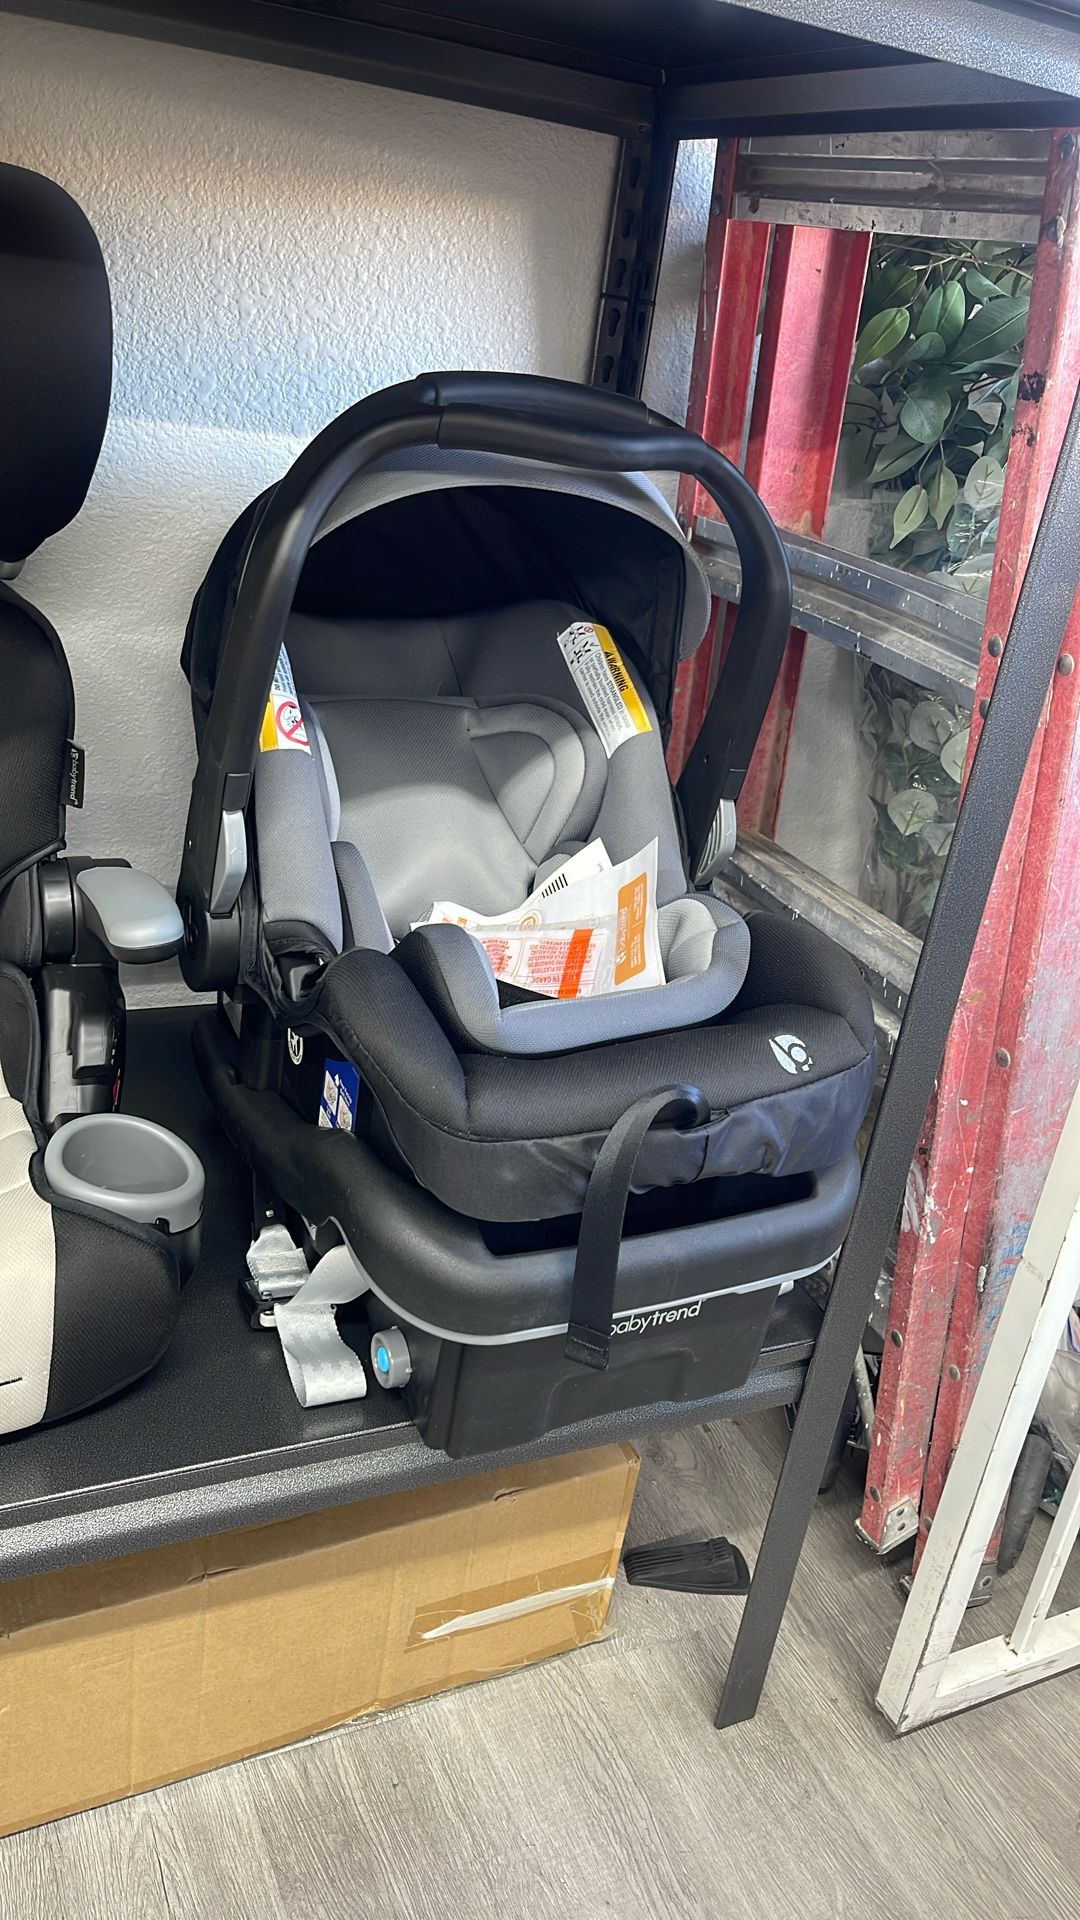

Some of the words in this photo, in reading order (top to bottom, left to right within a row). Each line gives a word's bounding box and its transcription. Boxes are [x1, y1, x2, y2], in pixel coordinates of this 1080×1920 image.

[606, 656, 629, 691] WARNING
[605, 680, 622, 710] STRANGLED
[69, 759, 78, 800] babytrend
